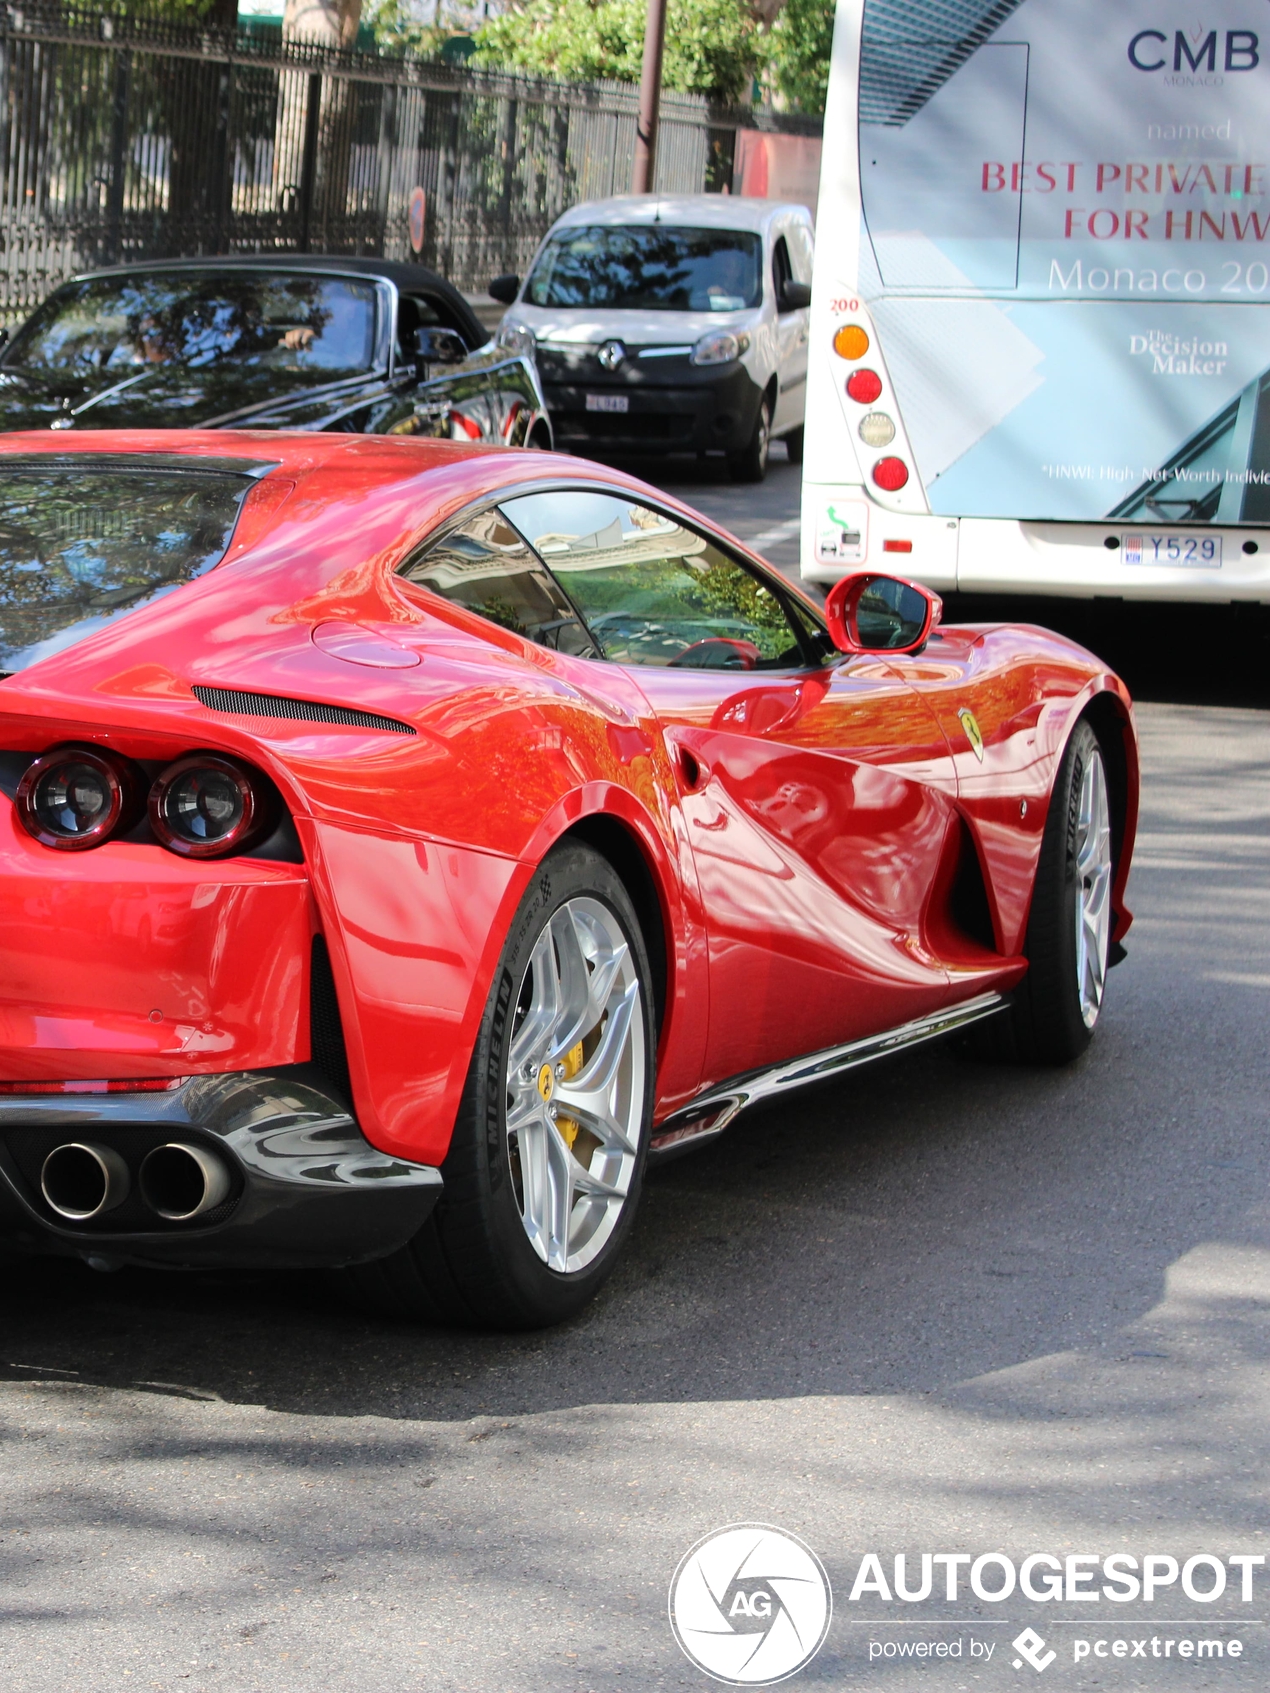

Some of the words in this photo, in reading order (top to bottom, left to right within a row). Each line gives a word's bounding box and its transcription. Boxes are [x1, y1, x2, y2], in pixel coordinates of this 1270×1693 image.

[1128, 29, 1260, 73] CMB
[1163, 75, 1225, 88] MONACO
[1148, 119, 1231, 139] named
[981, 162, 1084, 193] BEST
[1096, 163, 1266, 196] PRIVATE
[1064, 208, 1149, 241] FOR
[1048, 258, 1206, 293] Monaco
[1221, 261, 1270, 293] 20
[830, 298, 859, 311] 200
[1129, 335, 1228, 356] Decision
[1146, 329, 1172, 343] The
[1152, 353, 1227, 375] Maker
[1151, 538, 1215, 561] Y529
[486, 976, 513, 1145] MICHELIN
